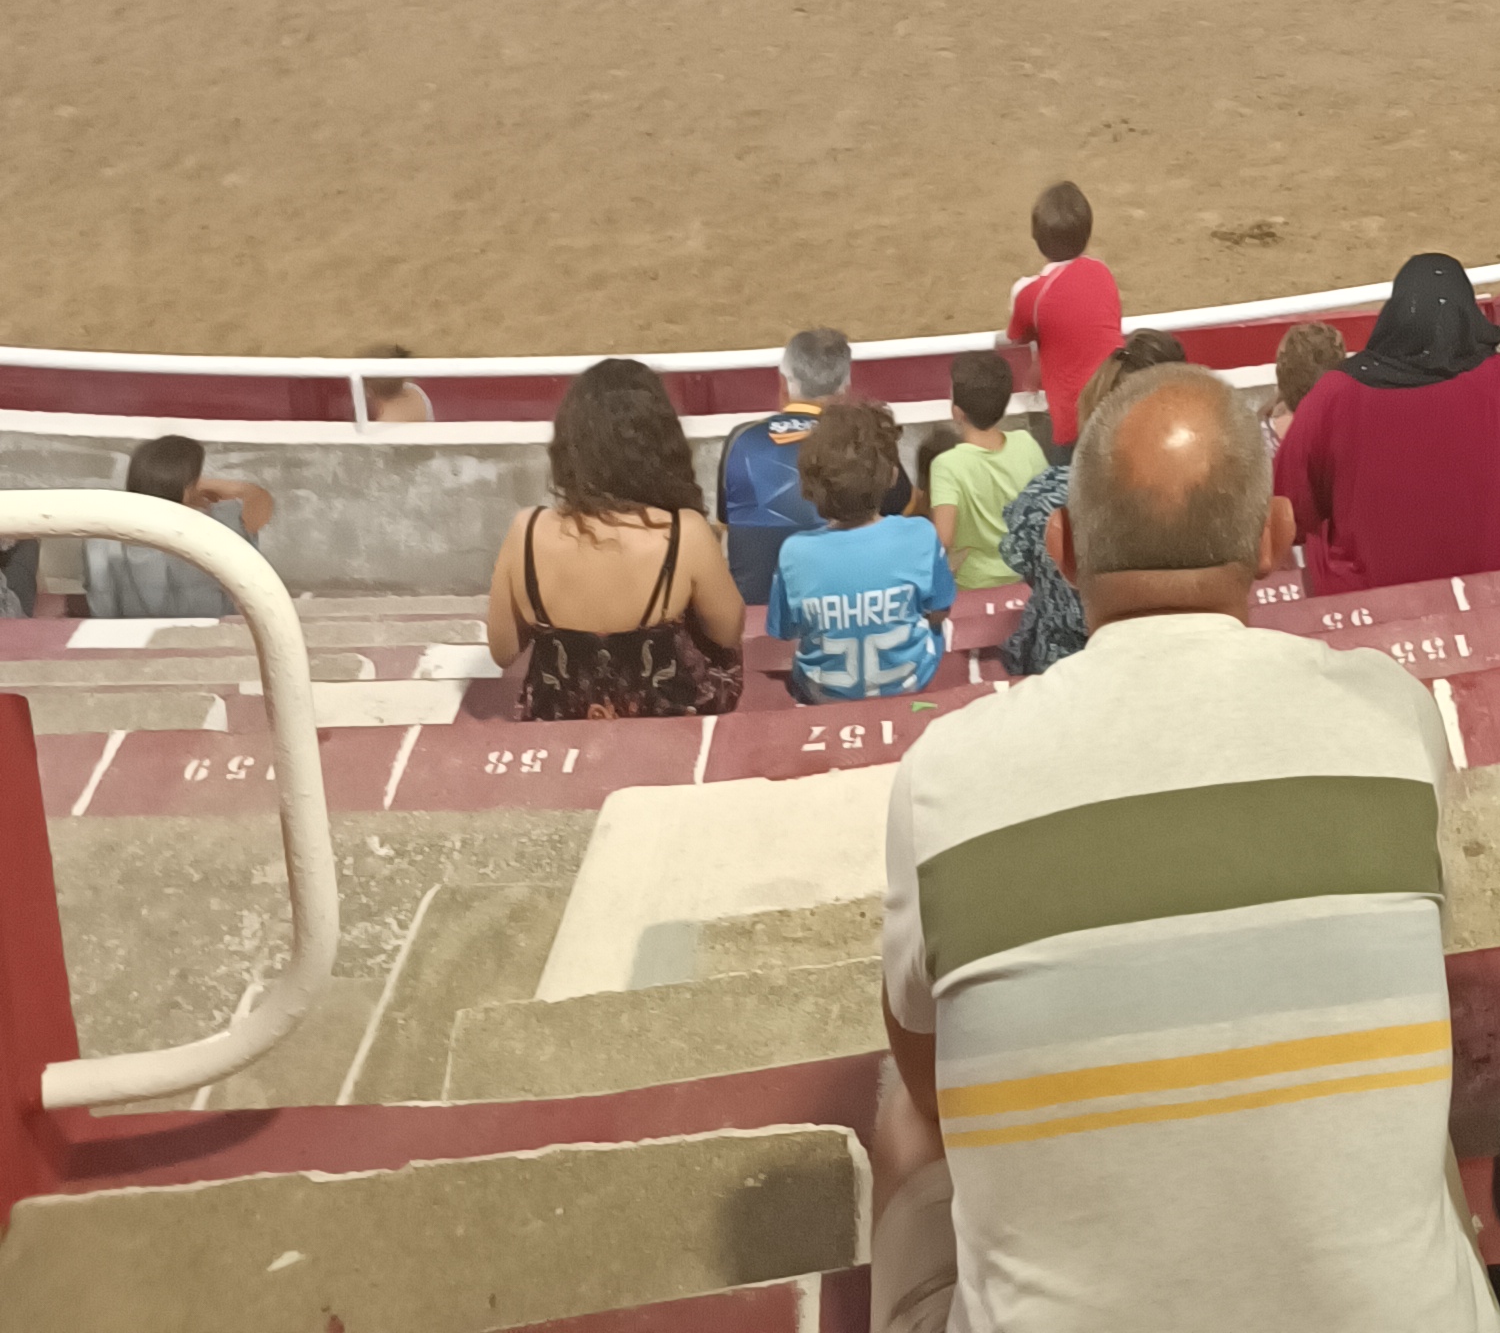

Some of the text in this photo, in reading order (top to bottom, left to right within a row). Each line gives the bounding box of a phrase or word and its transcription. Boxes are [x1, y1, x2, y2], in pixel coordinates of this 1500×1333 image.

[802, 584, 915, 630] MAHREZ
[801, 720, 895, 752] 157
[484, 748, 580, 775] 158
